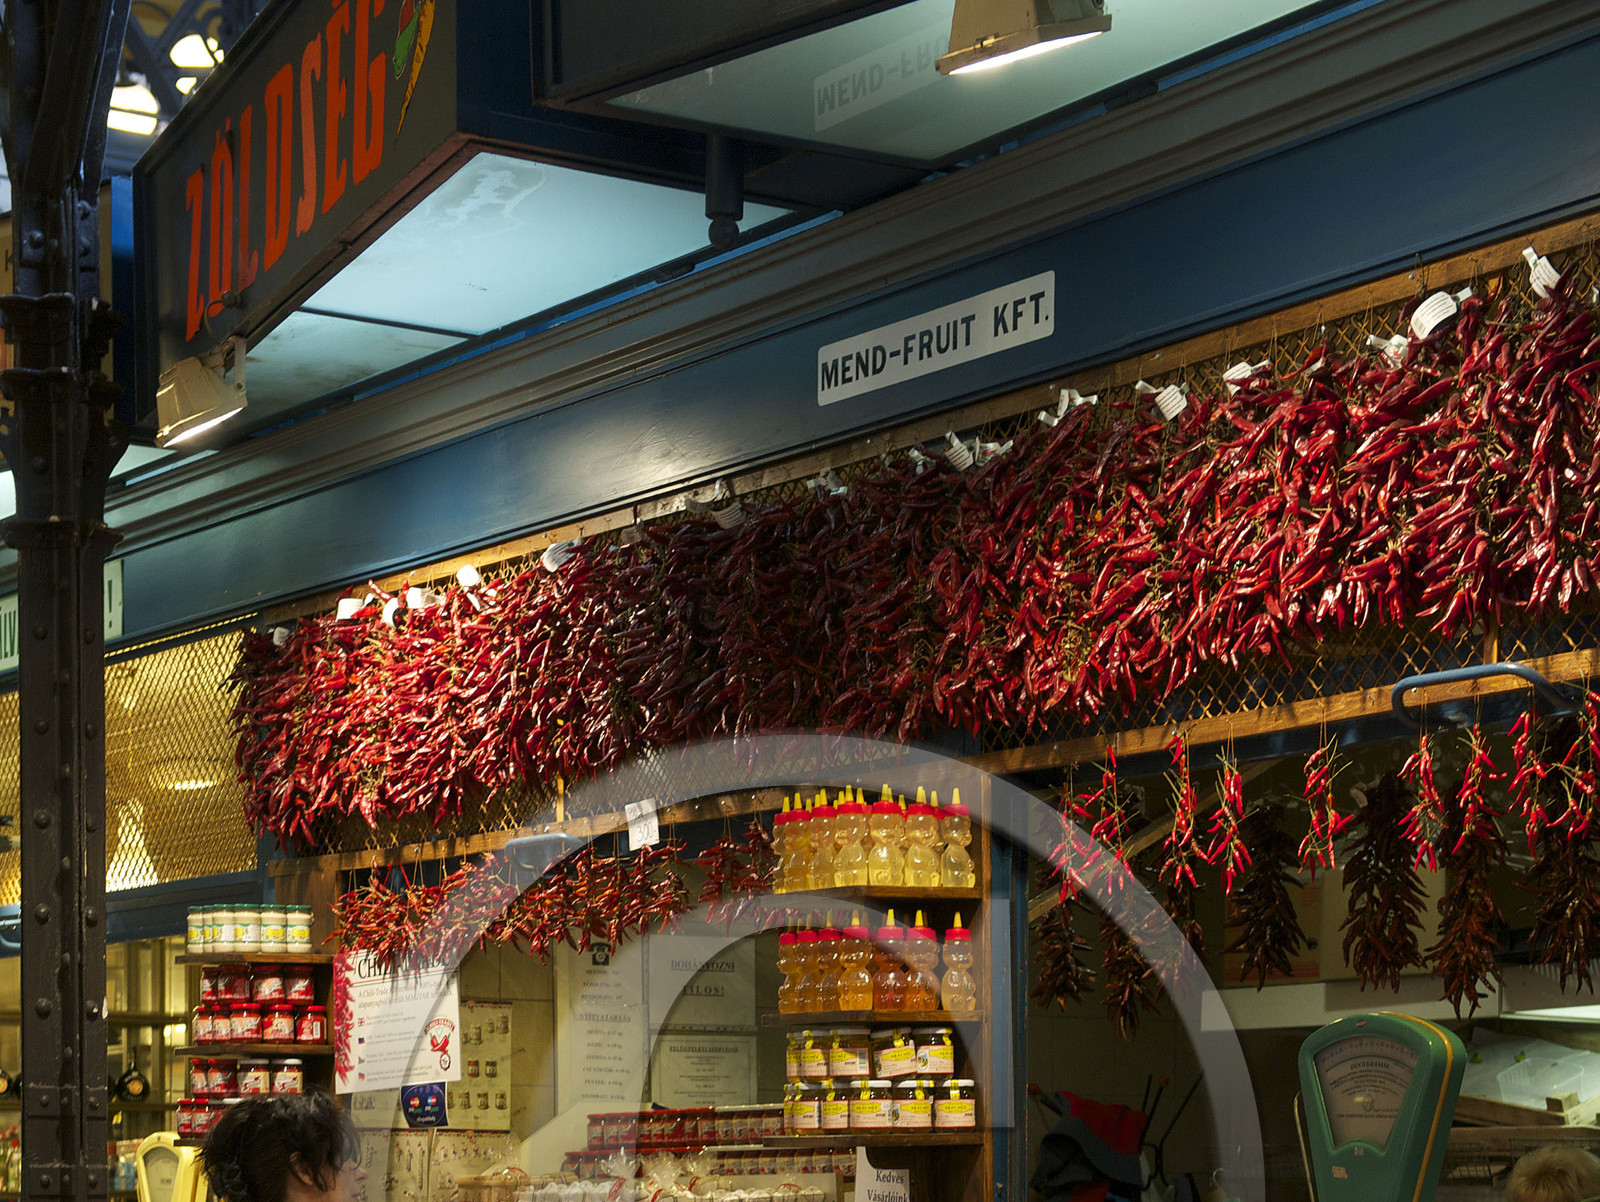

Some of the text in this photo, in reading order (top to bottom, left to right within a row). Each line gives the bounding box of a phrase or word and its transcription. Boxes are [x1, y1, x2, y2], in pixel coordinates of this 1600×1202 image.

[186, 0, 386, 342] ZÖLDSÉG
[821, 290, 1049, 391] MEND-FRUIT KFT.
[876, 1169, 904, 1184] Kedves
